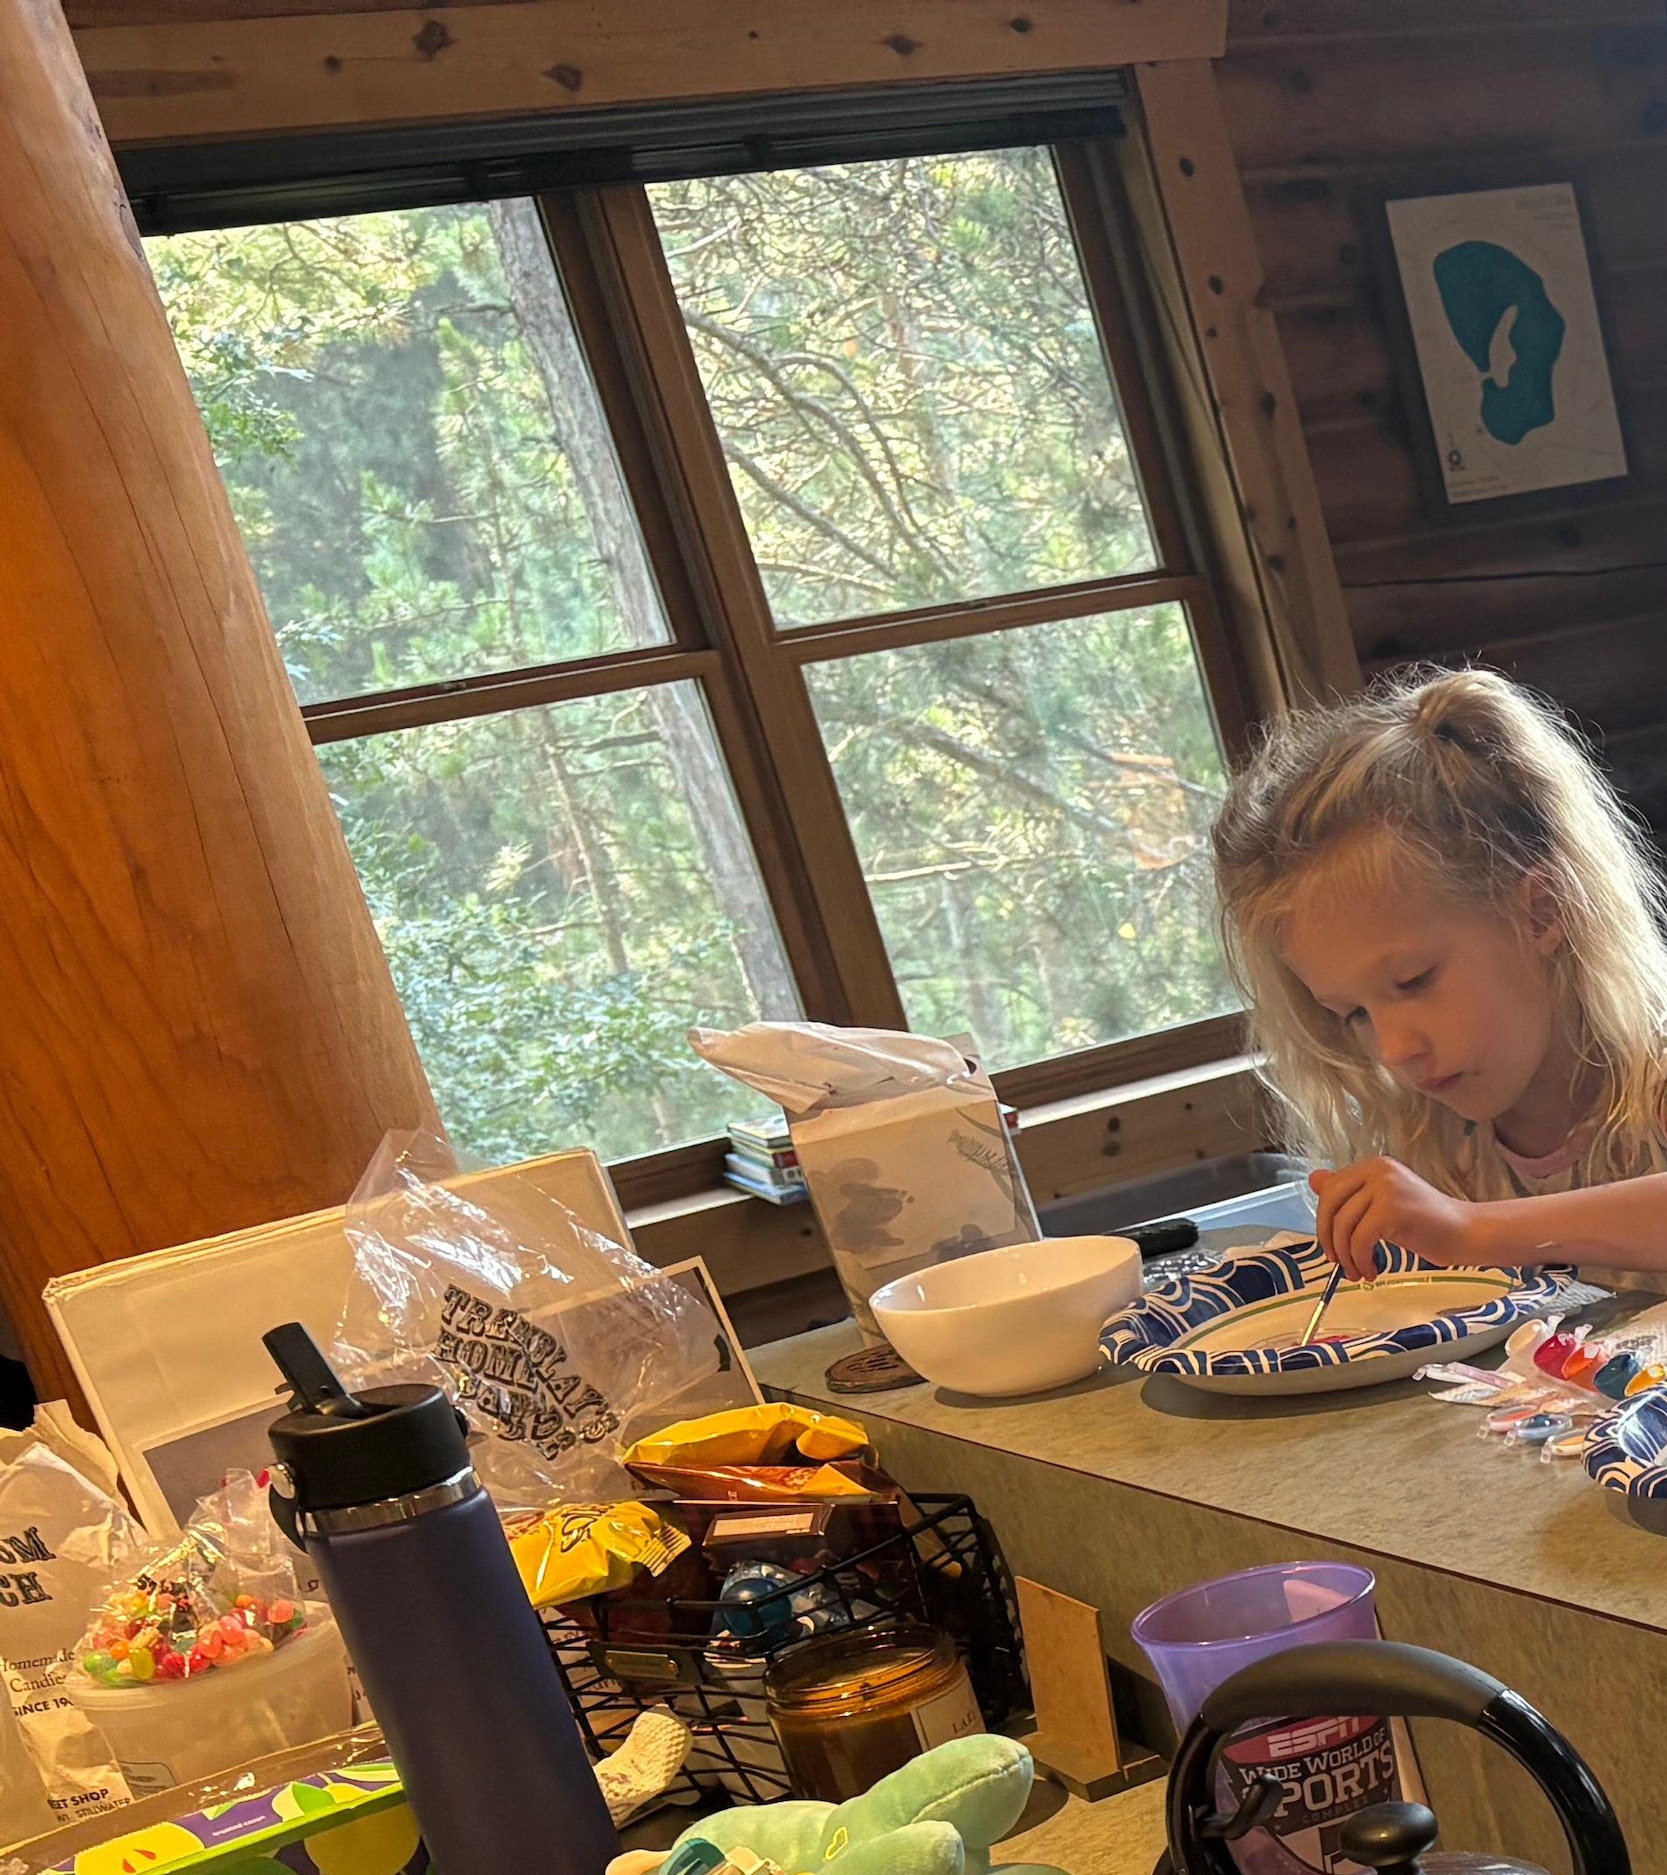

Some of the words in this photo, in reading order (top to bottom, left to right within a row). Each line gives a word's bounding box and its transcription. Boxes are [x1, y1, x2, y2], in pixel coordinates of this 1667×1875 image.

[1, 1648, 76, 1672] omemde
[1303, 1737, 1373, 1775] WORLD
[1242, 1739, 1394, 1818] PORTS
[70, 1788, 109, 1806] SHOP
